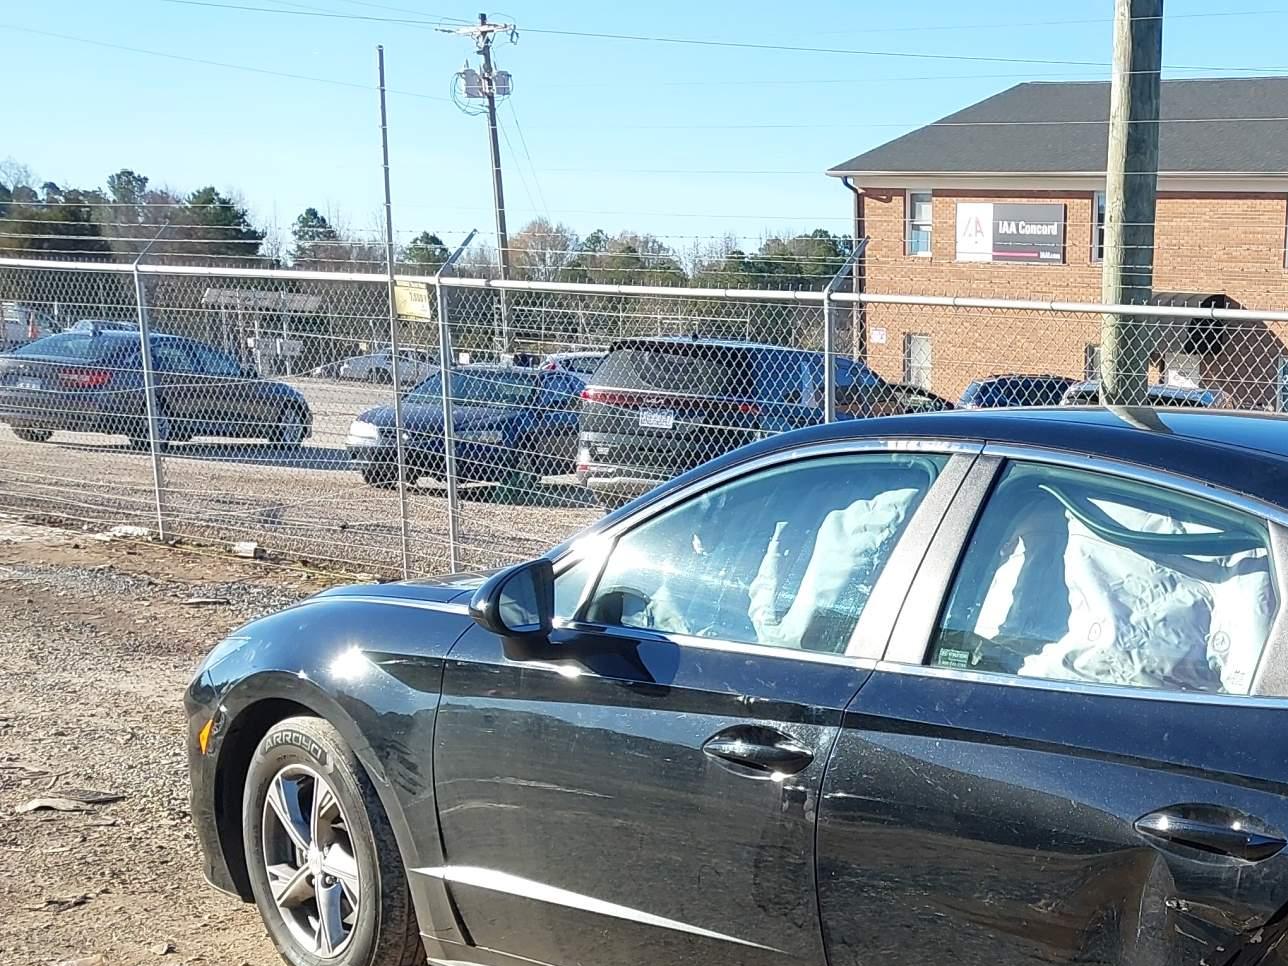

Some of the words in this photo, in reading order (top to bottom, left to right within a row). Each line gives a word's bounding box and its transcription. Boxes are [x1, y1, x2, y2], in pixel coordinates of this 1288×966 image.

[998, 220, 1017, 234] IAA
[1018, 221, 1058, 235] Concord
[264, 730, 322, 760] ARROYO
